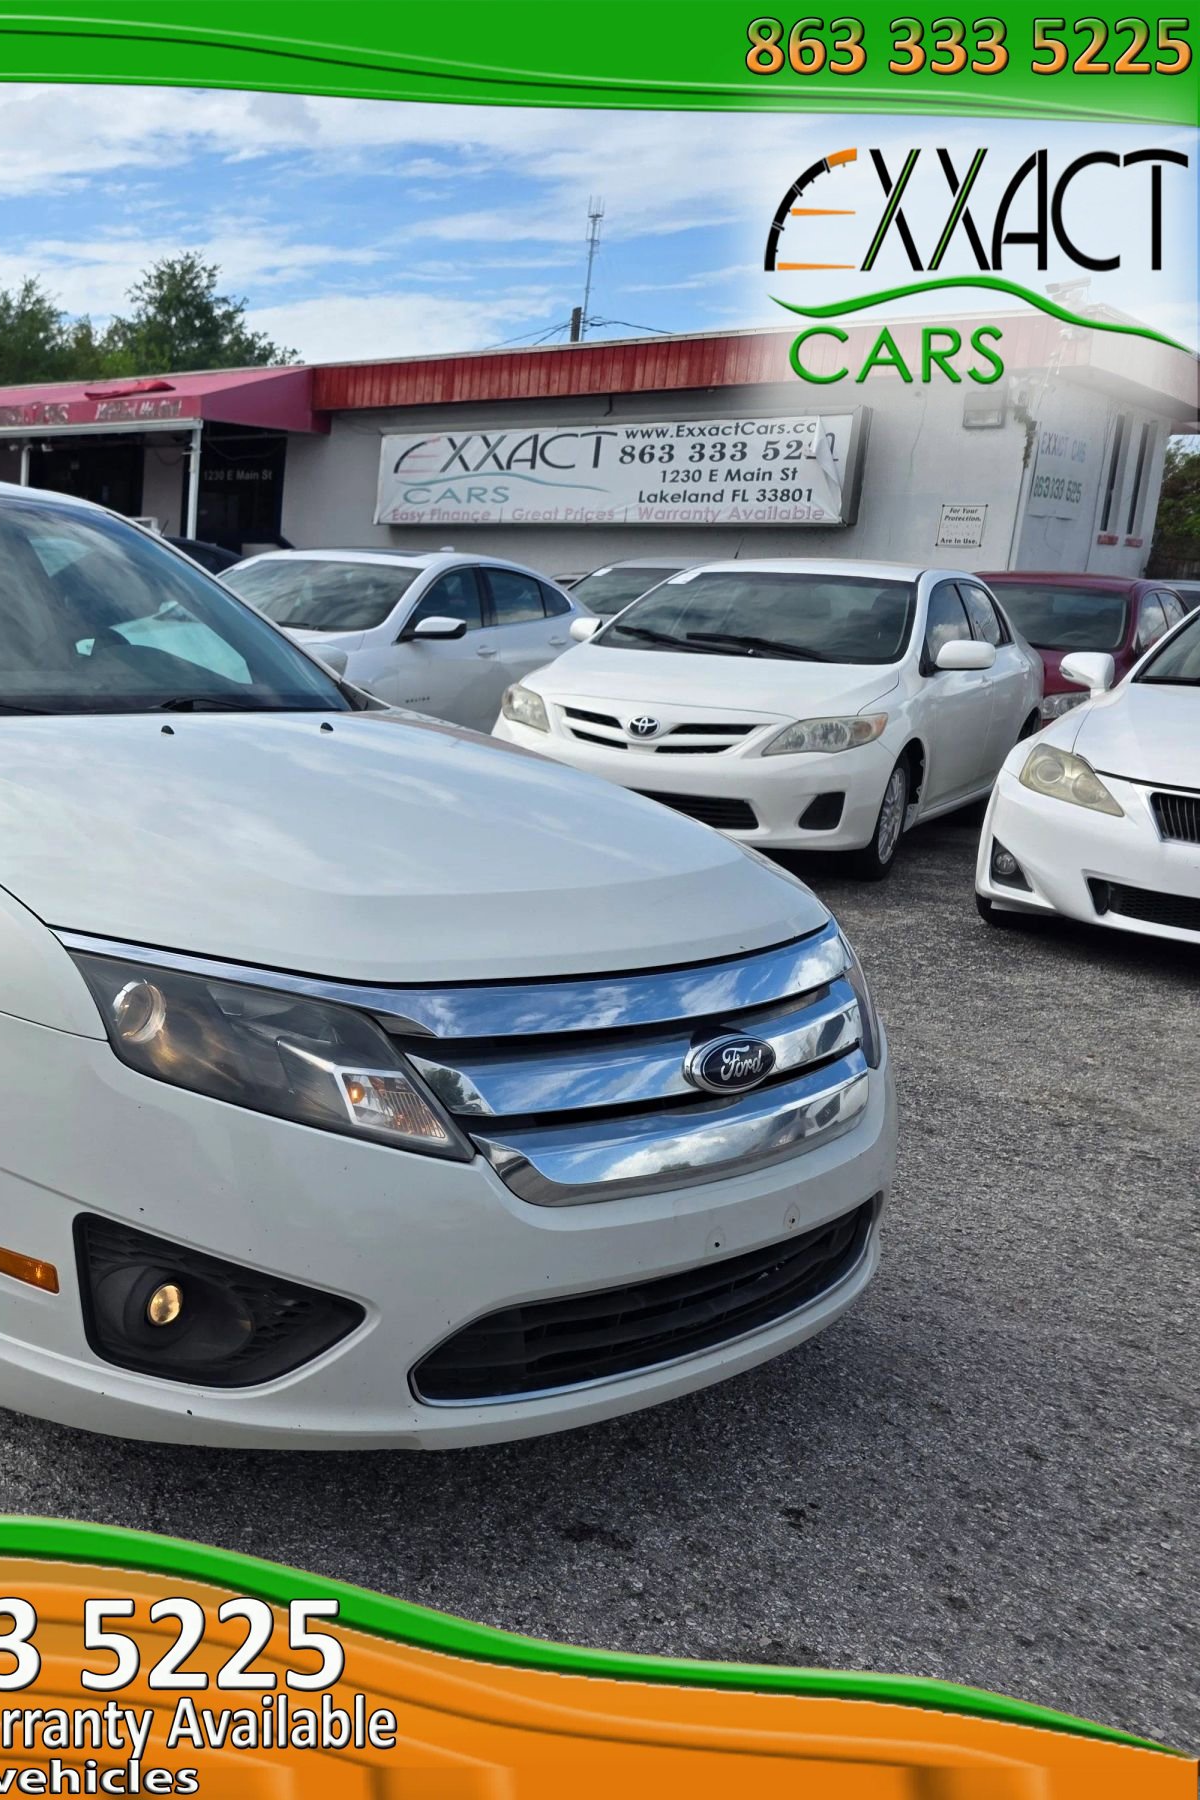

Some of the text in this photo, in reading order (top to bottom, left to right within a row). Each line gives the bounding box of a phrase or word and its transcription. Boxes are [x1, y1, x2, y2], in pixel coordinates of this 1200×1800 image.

[625, 421, 817, 439] www.ExxactCars.co
[393, 431, 618, 474] EXXACT
[619, 444, 675, 465] 863
[688, 441, 748, 463] 333
[226, 469, 234, 480] E
[235, 469, 260, 480] Main
[660, 467, 798, 483] 1230 E Main St
[402, 486, 510, 505] CARS
[638, 488, 813, 504] Lakeland FL 33801
[391, 505, 825, 524] Easy Finance Great Prices Warranty Available
[720, 1045, 763, 1081] Ford
